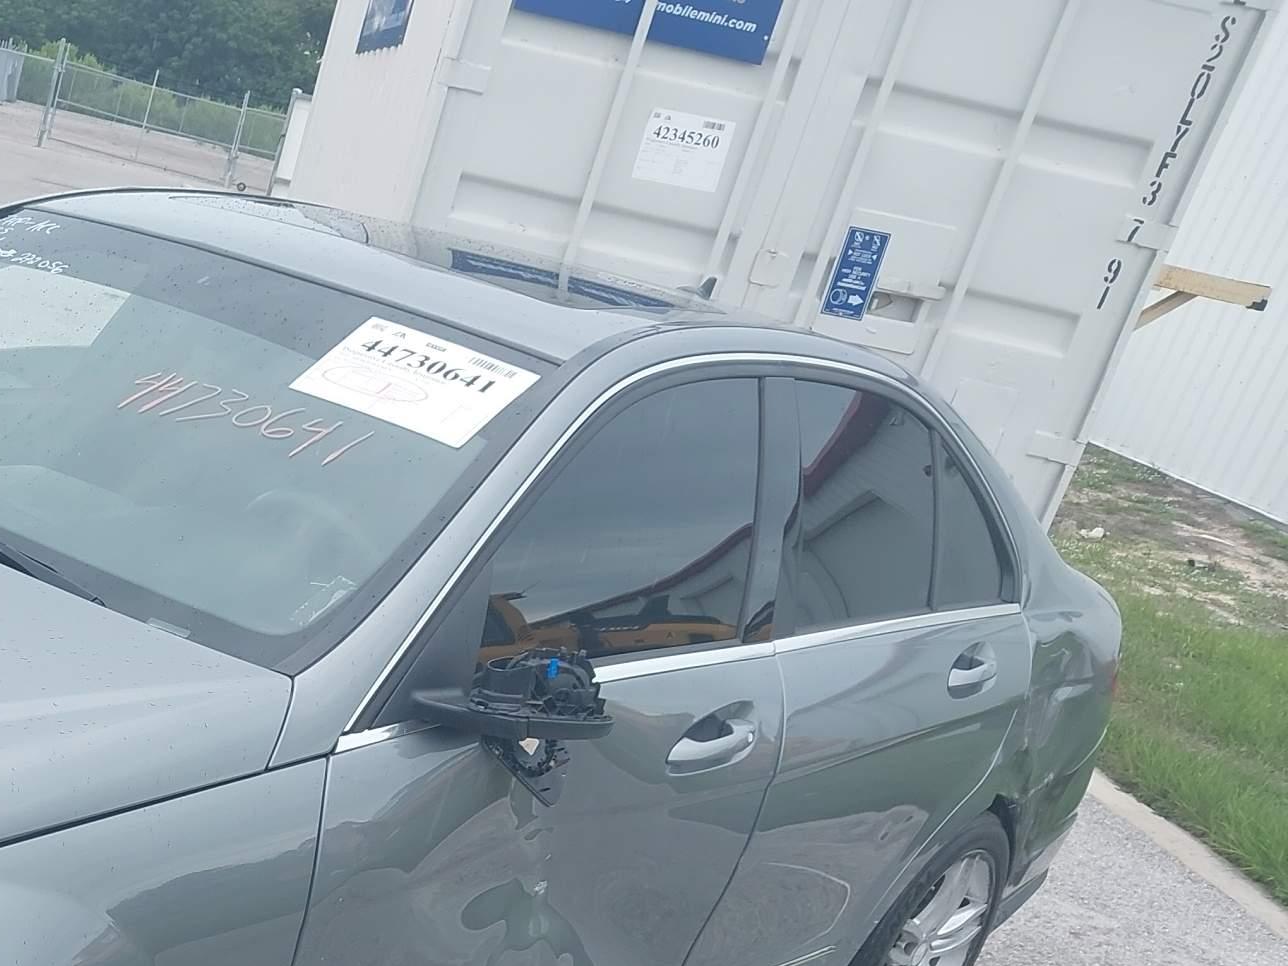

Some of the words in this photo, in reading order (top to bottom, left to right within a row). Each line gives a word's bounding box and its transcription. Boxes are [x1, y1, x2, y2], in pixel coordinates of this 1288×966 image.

[652, 125, 720, 149] 42345260
[361, 339, 496, 393] 44730641
[117, 372, 375, 466] 44730641
